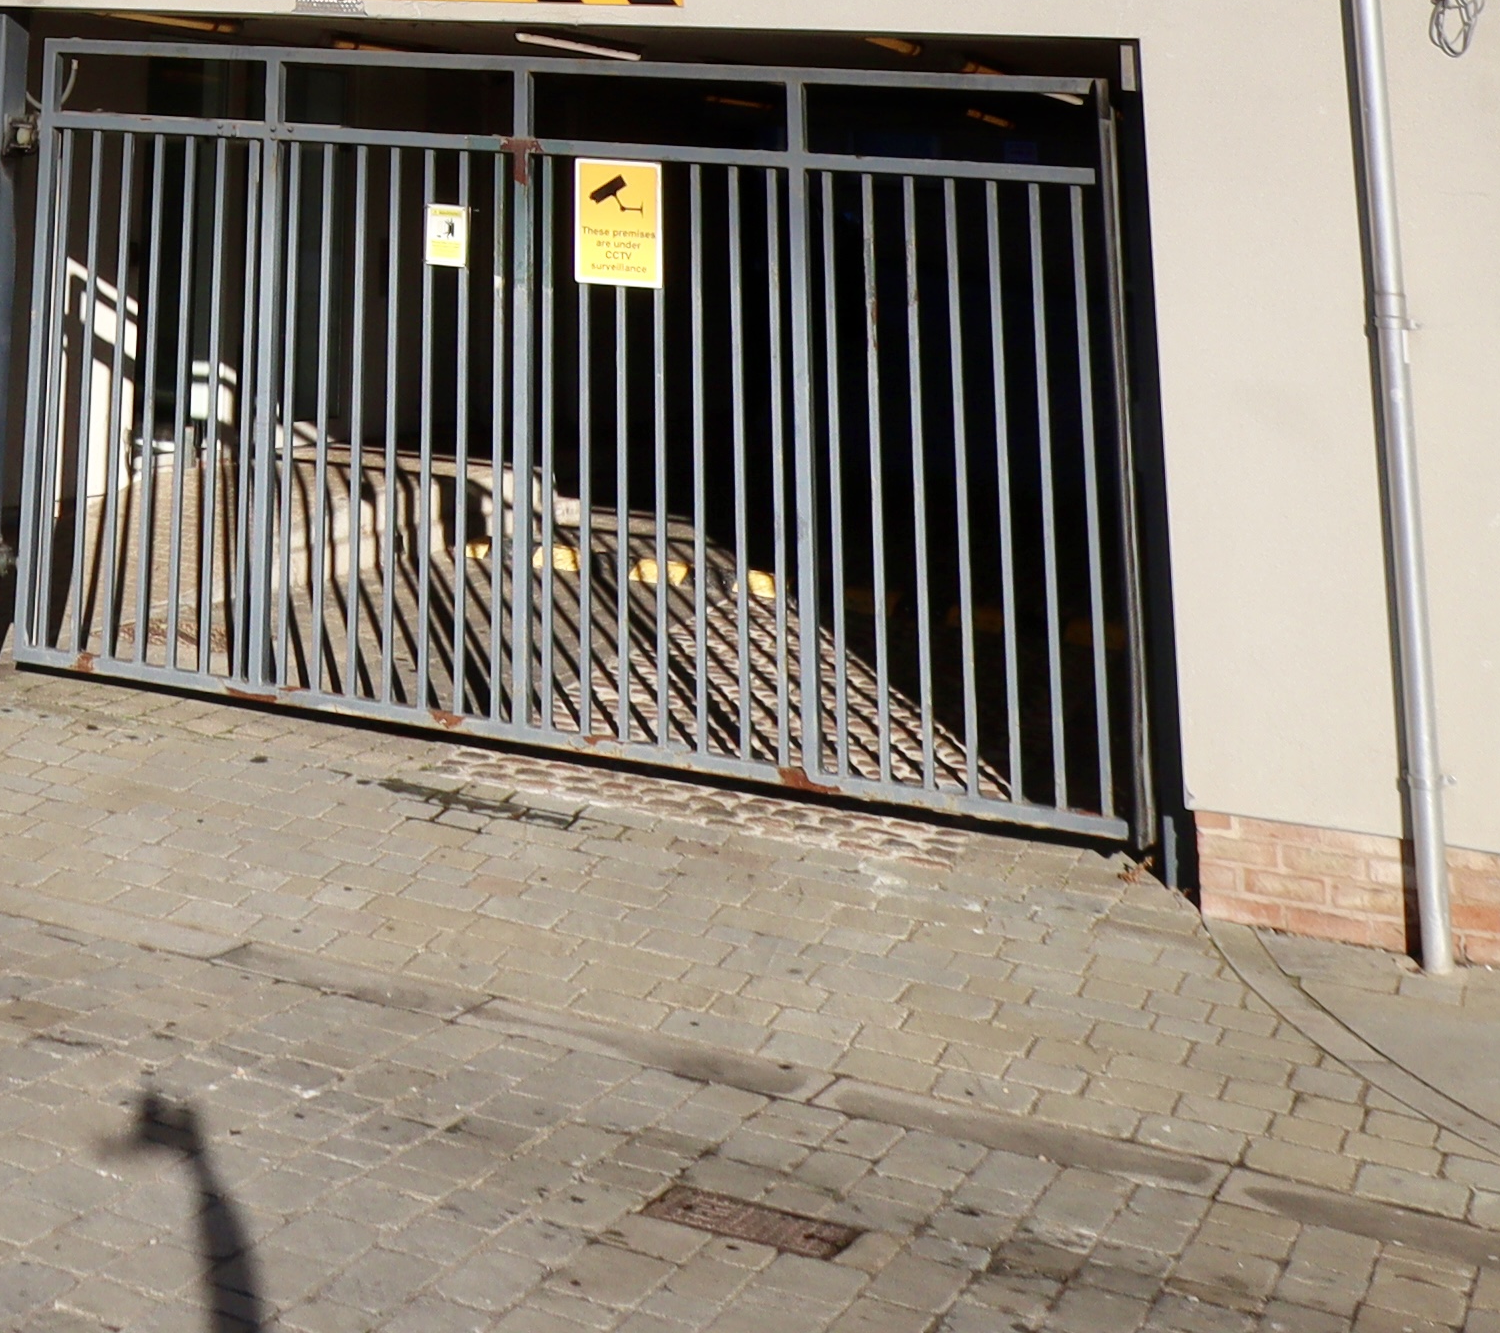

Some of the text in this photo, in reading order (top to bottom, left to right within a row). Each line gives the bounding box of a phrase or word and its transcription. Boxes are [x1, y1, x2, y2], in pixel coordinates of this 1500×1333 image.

[582, 226, 656, 239] These premises
[596, 240, 641, 250] are under
[605, 250, 632, 260] CCTV
[591, 262, 648, 274] surveillance
